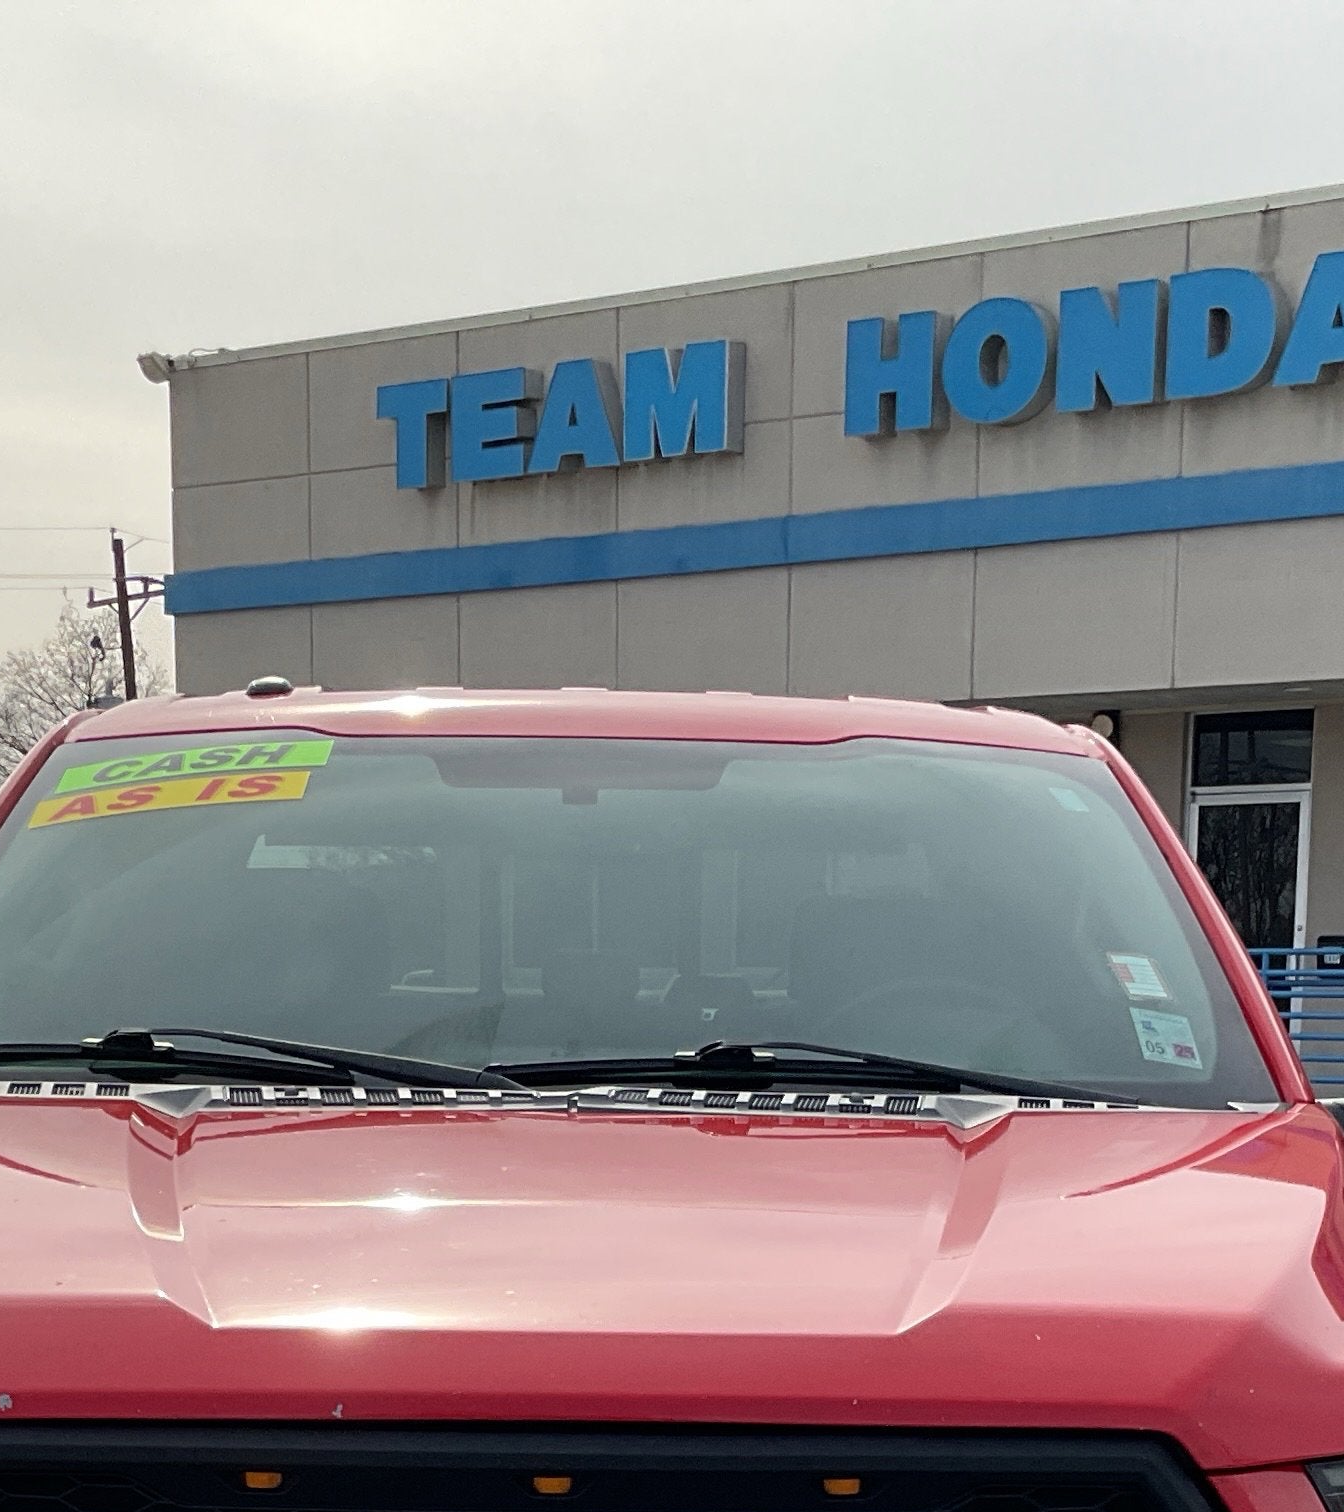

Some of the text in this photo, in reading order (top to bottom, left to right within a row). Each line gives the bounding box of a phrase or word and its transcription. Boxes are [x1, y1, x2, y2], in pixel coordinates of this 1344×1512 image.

[376, 340, 742, 490] TEAM
[92, 744, 295, 784] CASH
[48, 775, 284, 822] AS IS
[1145, 1040, 1165, 1055] 05
